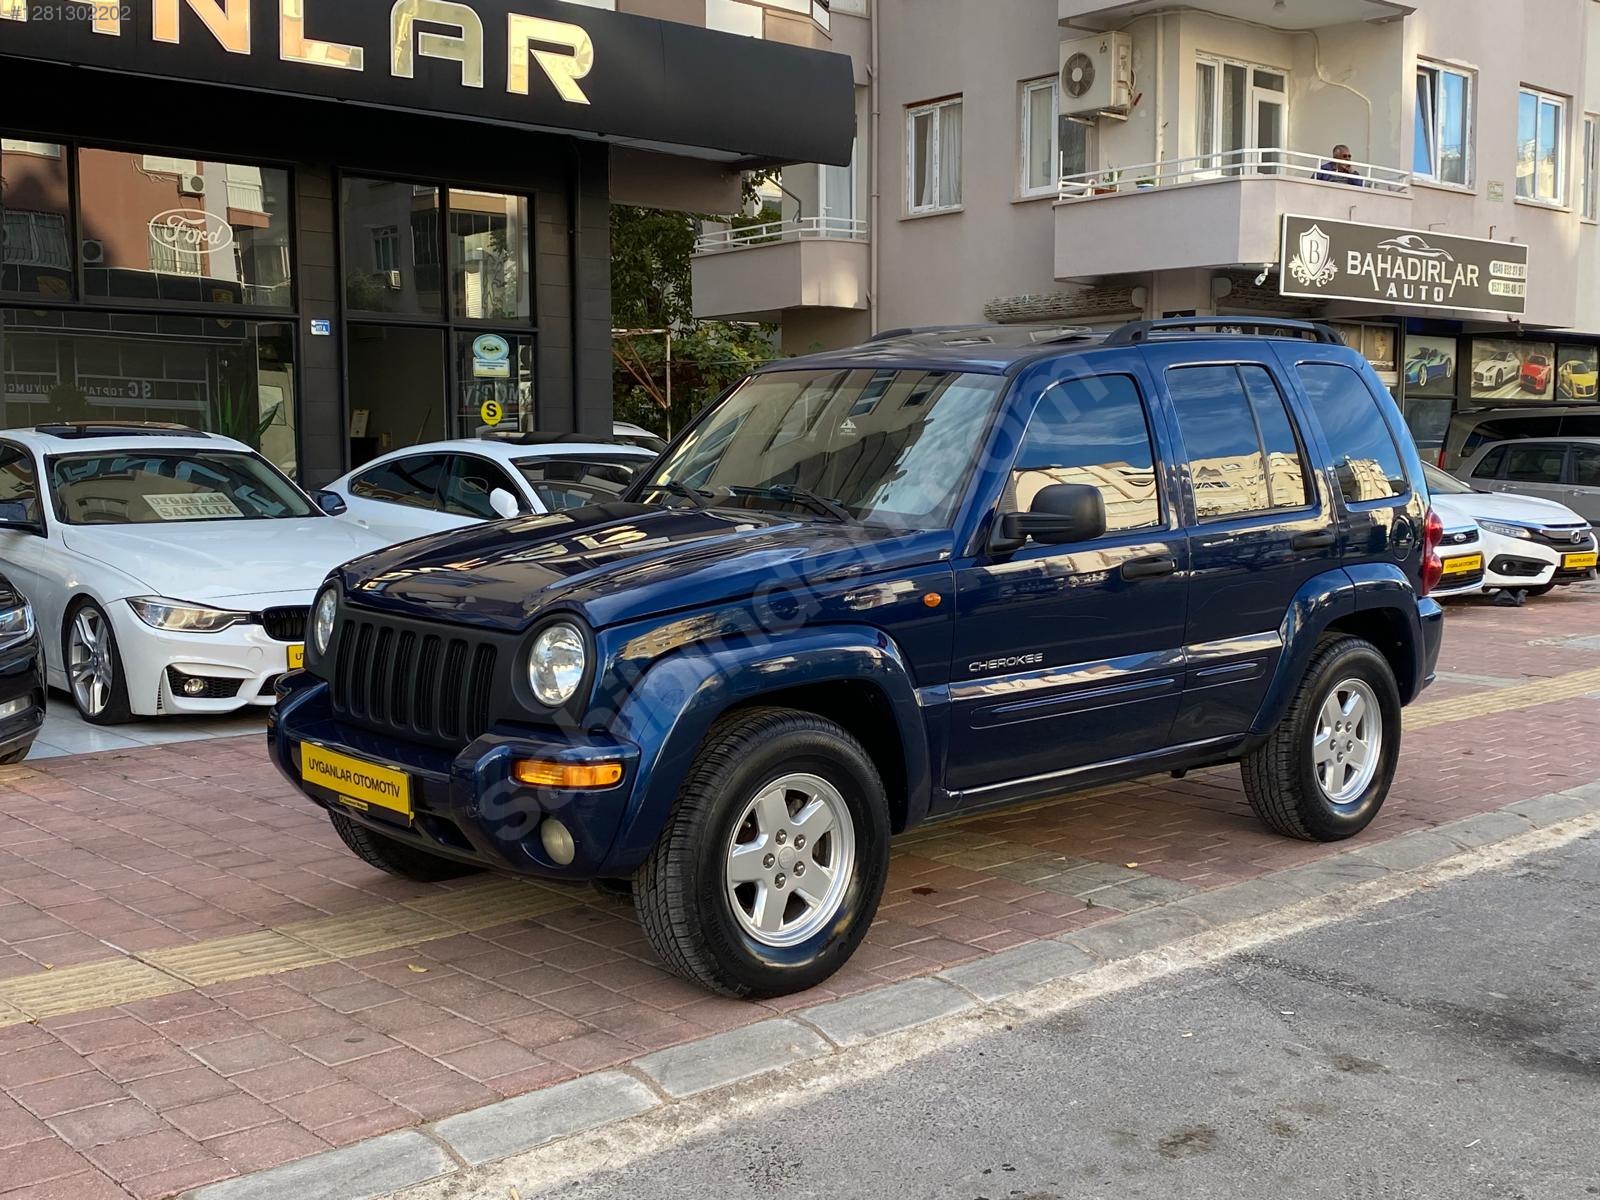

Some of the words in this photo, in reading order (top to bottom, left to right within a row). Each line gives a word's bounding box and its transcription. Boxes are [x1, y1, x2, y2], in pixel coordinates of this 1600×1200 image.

[164, 215, 223, 244] Ford
[1309, 240, 1320, 264] B
[1346, 250, 1479, 298] BAHADIRLAR
[1386, 282, 1444, 302] AUTO
[486, 403, 497, 417] S
[159, 505, 241, 518] SATILIK
[968, 652, 1044, 672] CHEROKEE
[308, 757, 352, 784] UYGANLAR
[352, 772, 401, 798] OTOMOTİV
